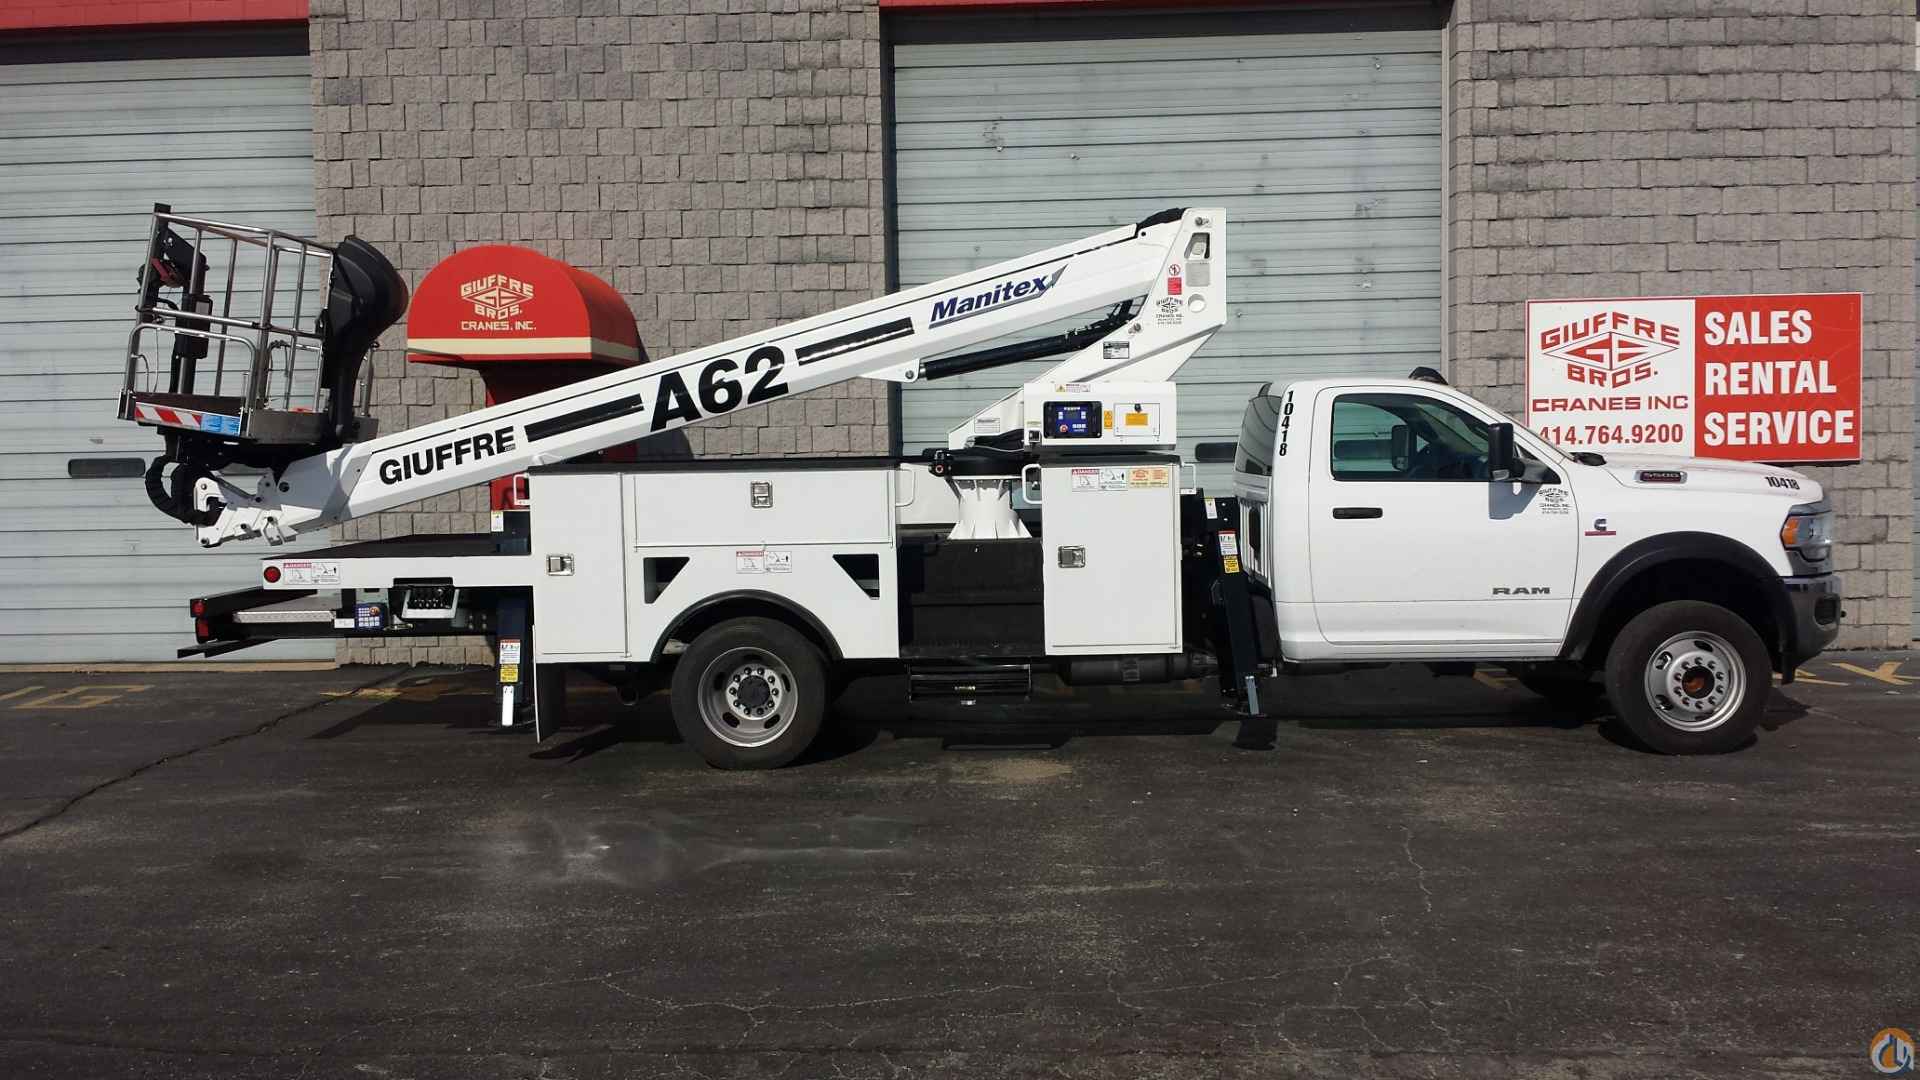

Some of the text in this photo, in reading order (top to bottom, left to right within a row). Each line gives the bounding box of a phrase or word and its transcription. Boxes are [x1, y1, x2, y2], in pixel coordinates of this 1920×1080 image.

[461, 274, 534, 297] GIUFFRE
[930, 275, 1048, 323] Manitex
[475, 304, 523, 320] BROS.
[1704, 310, 1813, 346] SALES
[1540, 311, 1681, 350] GIUFFRE
[650, 345, 790, 433] A62
[1567, 362, 1659, 389] BROS.
[1705, 360, 1837, 396] RENTAL
[1532, 395, 1689, 413] CRANES INC
[1279, 390, 1294, 456] 10418
[1704, 410, 1854, 446] SERVICE
[379, 425, 515, 485] GIUFFRE
[1764, 476, 1801, 490] 10418
[1492, 587, 1551, 595] RAM
